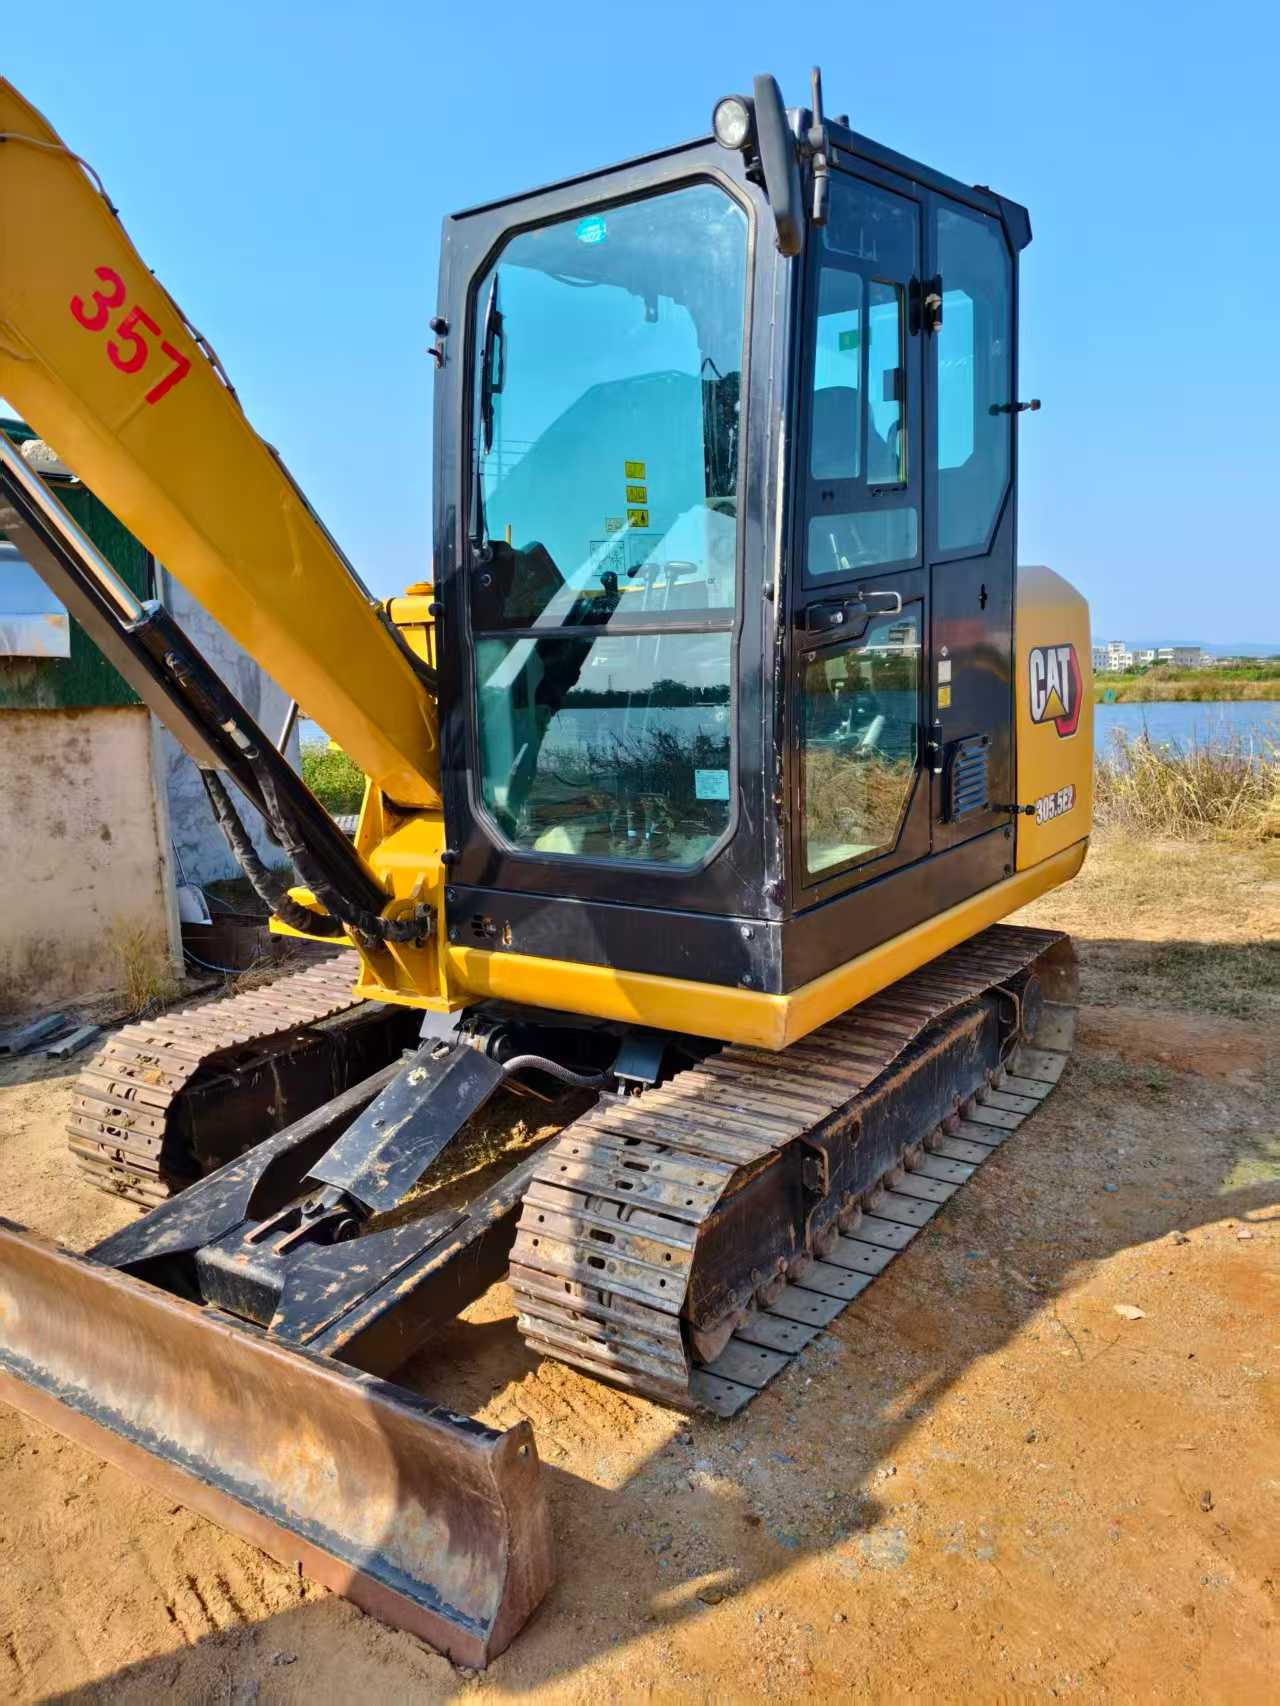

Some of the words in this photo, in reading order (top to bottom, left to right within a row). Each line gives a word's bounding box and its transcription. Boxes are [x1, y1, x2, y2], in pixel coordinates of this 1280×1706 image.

[70, 266, 191, 406] 357
[1030, 647, 1071, 722] CAT
[1036, 785, 1073, 825] 305.5E2
